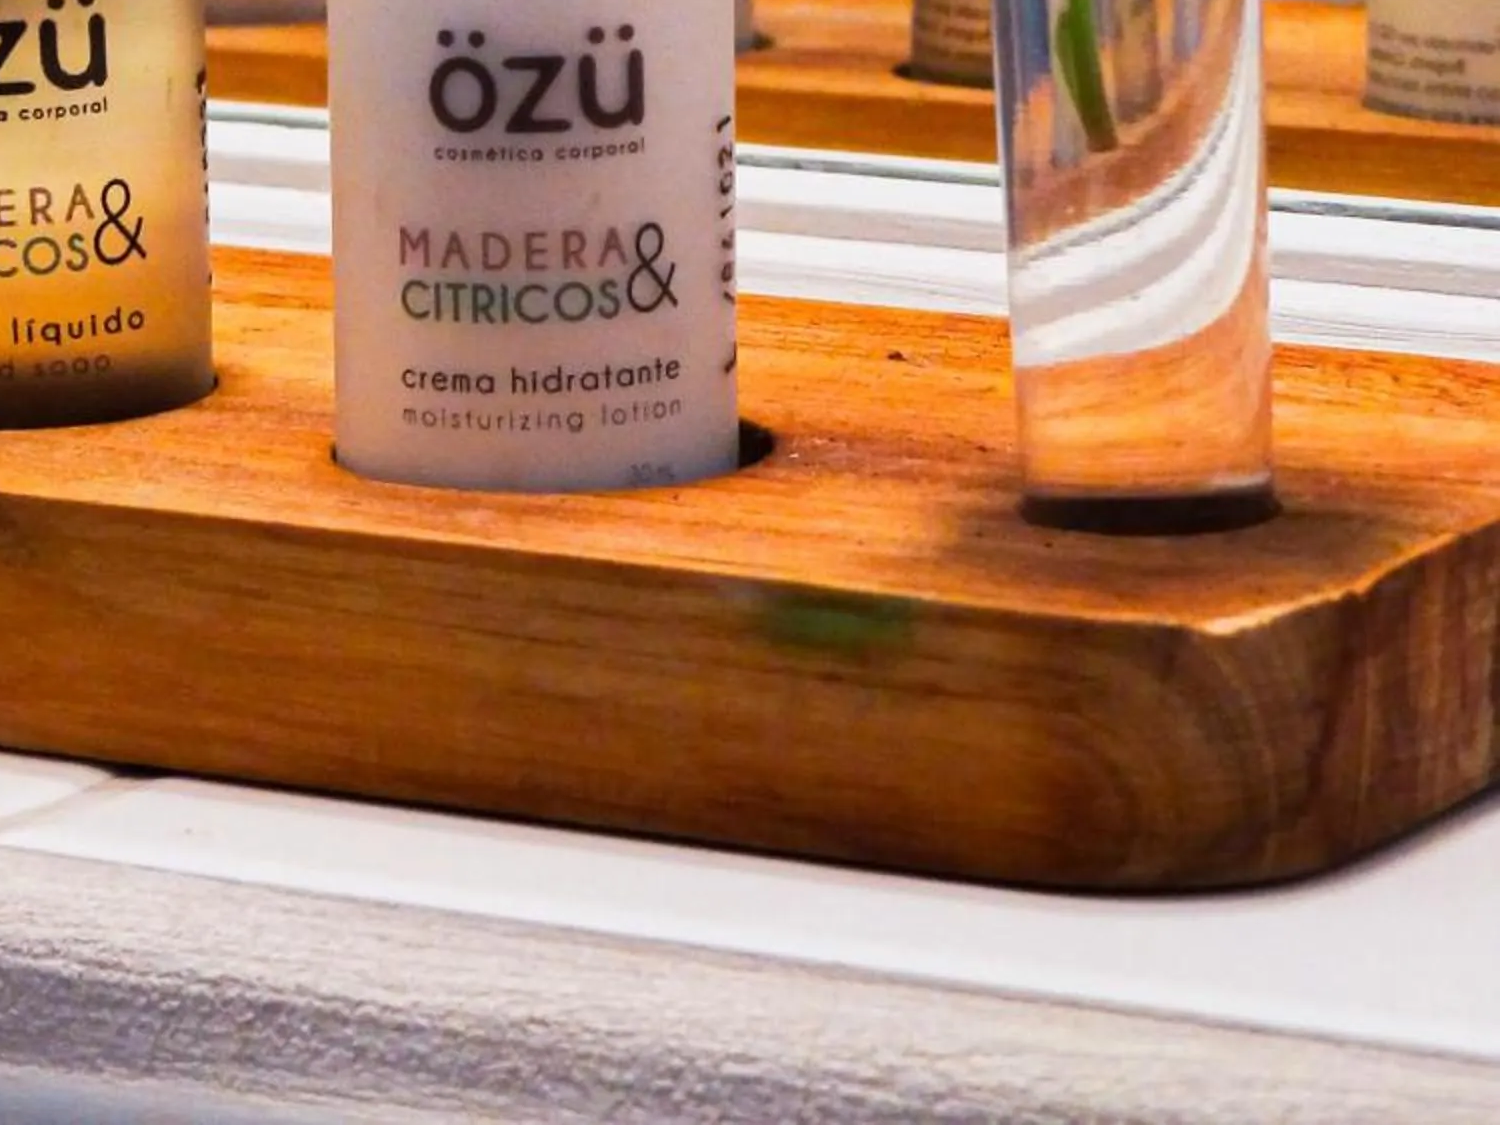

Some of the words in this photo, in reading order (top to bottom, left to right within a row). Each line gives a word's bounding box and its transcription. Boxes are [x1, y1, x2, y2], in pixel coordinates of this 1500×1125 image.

[18, 98, 109, 122] corporal
[433, 145, 544, 163] cosmética
[554, 137, 646, 161] corporal
[93, 177, 148, 265] &
[399, 226, 629, 271] MADERA
[627, 222, 679, 313] &
[401, 280, 621, 325] CITRICOS
[11, 305, 147, 347] líquido
[401, 367, 495, 394] crema
[510, 358, 682, 395] hidratante
[402, 405, 585, 433] moisturizing
[602, 397, 683, 427] lotion
